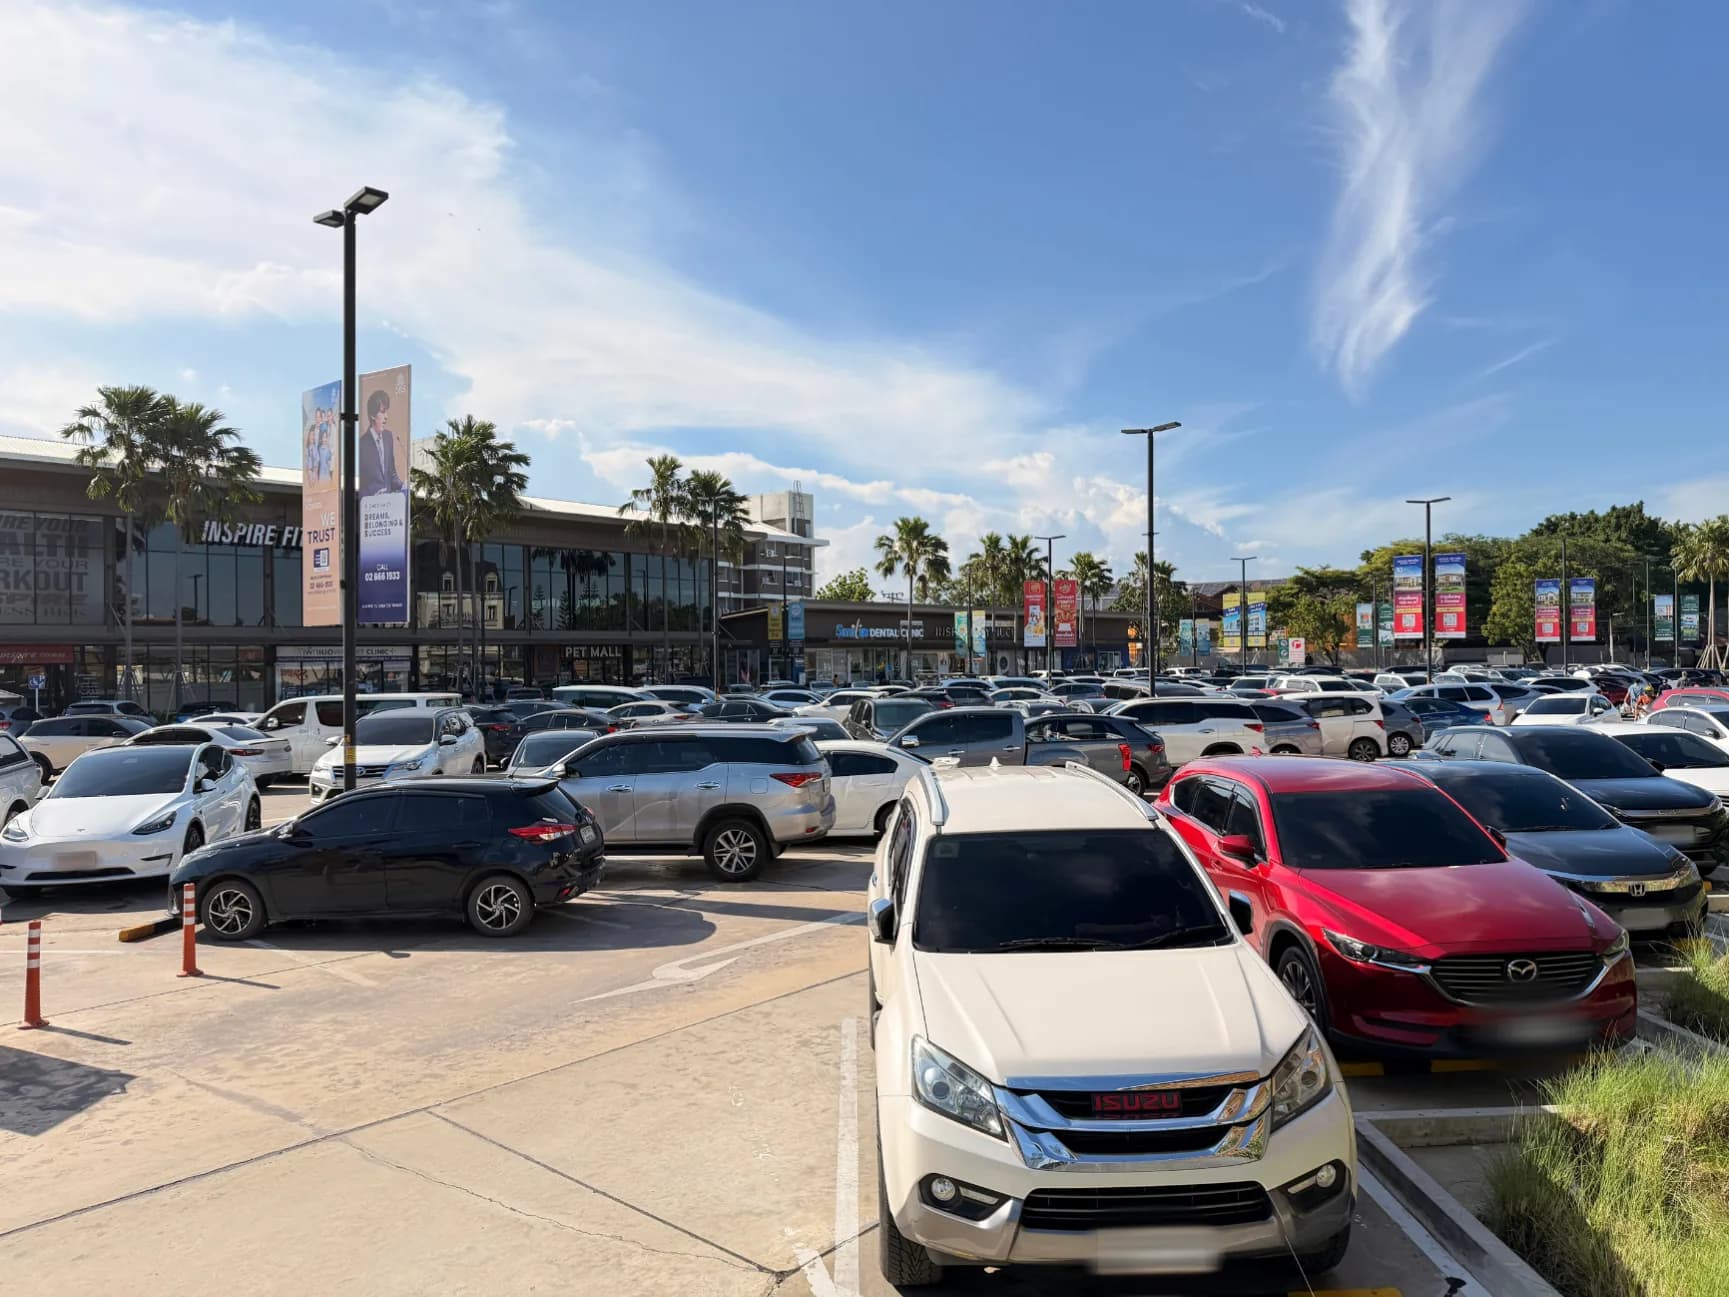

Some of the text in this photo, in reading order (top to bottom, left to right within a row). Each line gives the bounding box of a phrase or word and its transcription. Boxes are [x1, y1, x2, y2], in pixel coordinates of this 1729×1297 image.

[321, 512, 336, 526] WE
[201, 521, 277, 545] INSPIRE
[307, 528, 335, 544] TRUST
[364, 573, 374, 581] 02
[869, 628, 899, 637] DENTAL
[565, 646, 622, 658] PET MALL
[1095, 1093, 1179, 1111] ISUZU
